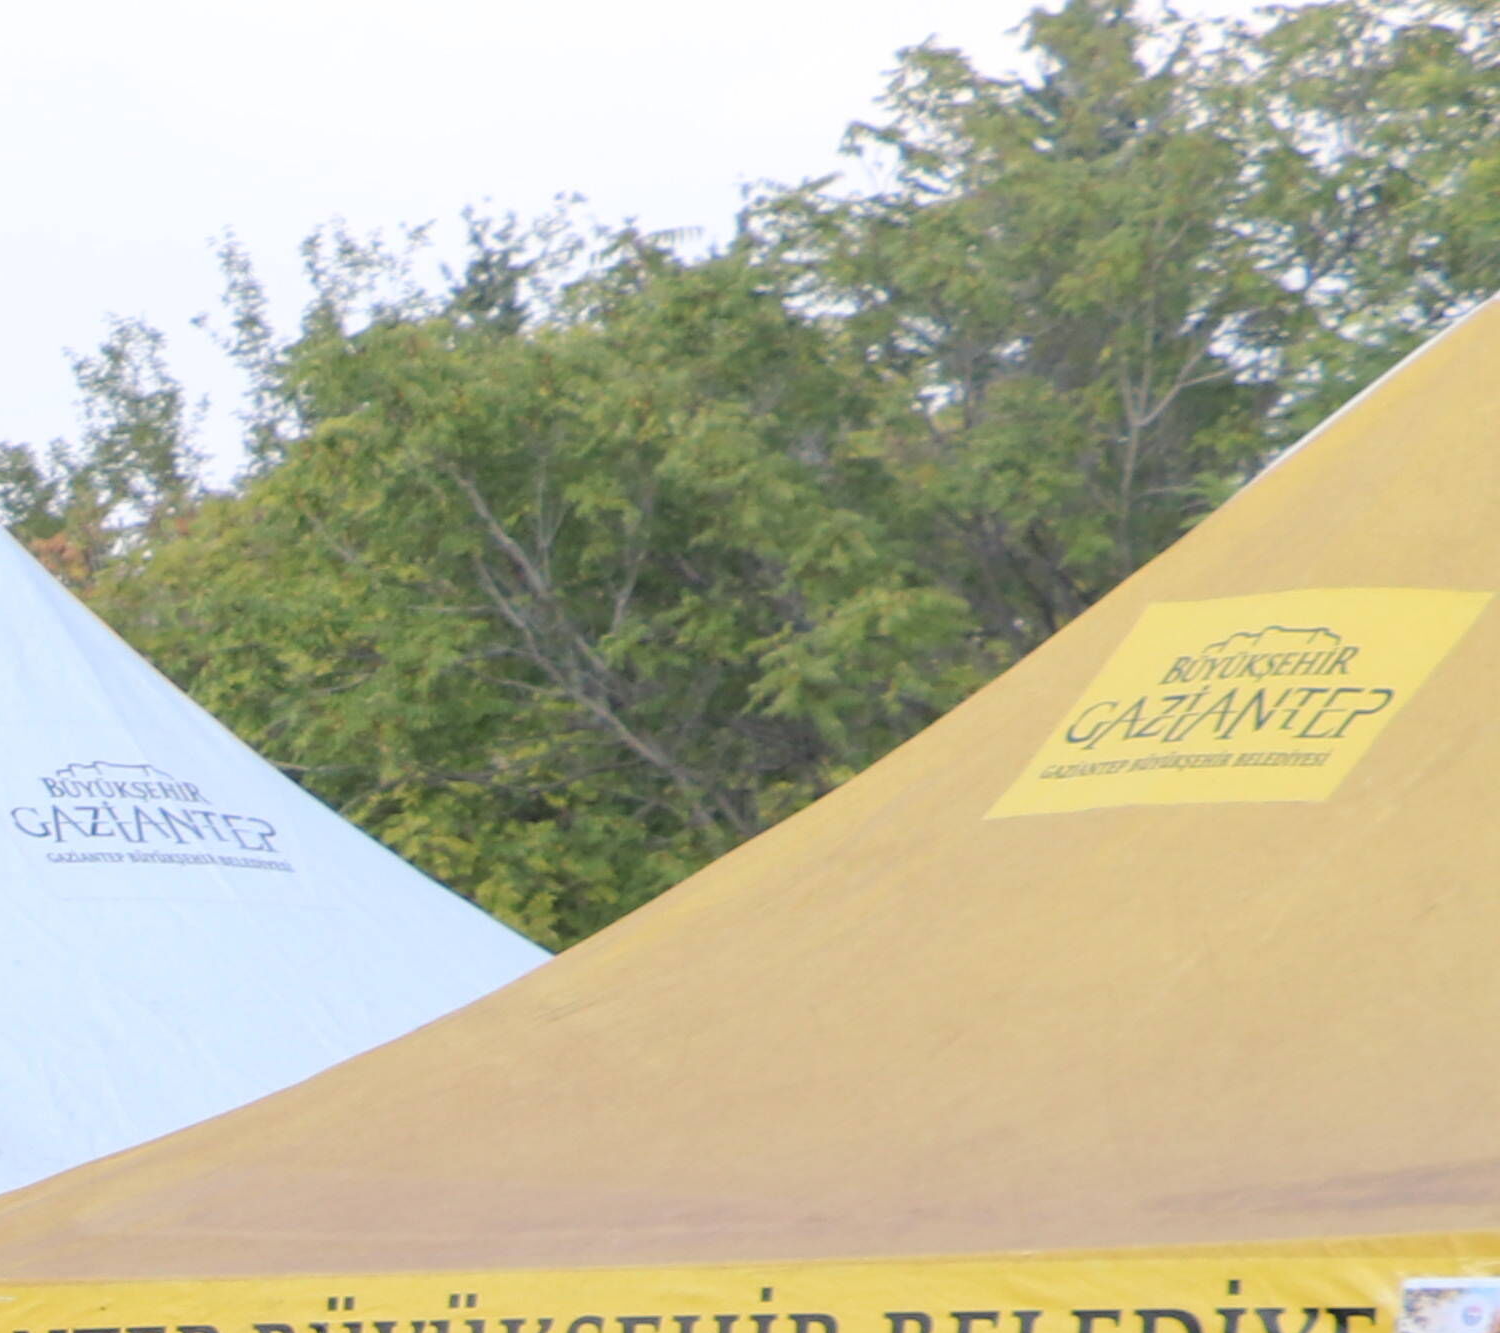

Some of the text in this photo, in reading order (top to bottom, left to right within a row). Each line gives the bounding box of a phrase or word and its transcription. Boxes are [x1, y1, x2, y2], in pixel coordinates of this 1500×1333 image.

[1159, 646, 1359, 685] BÜYÜKŞEHİR
[1065, 685, 1395, 750] GAZİANTEP
[10, 801, 280, 852] GAZİANTEP
